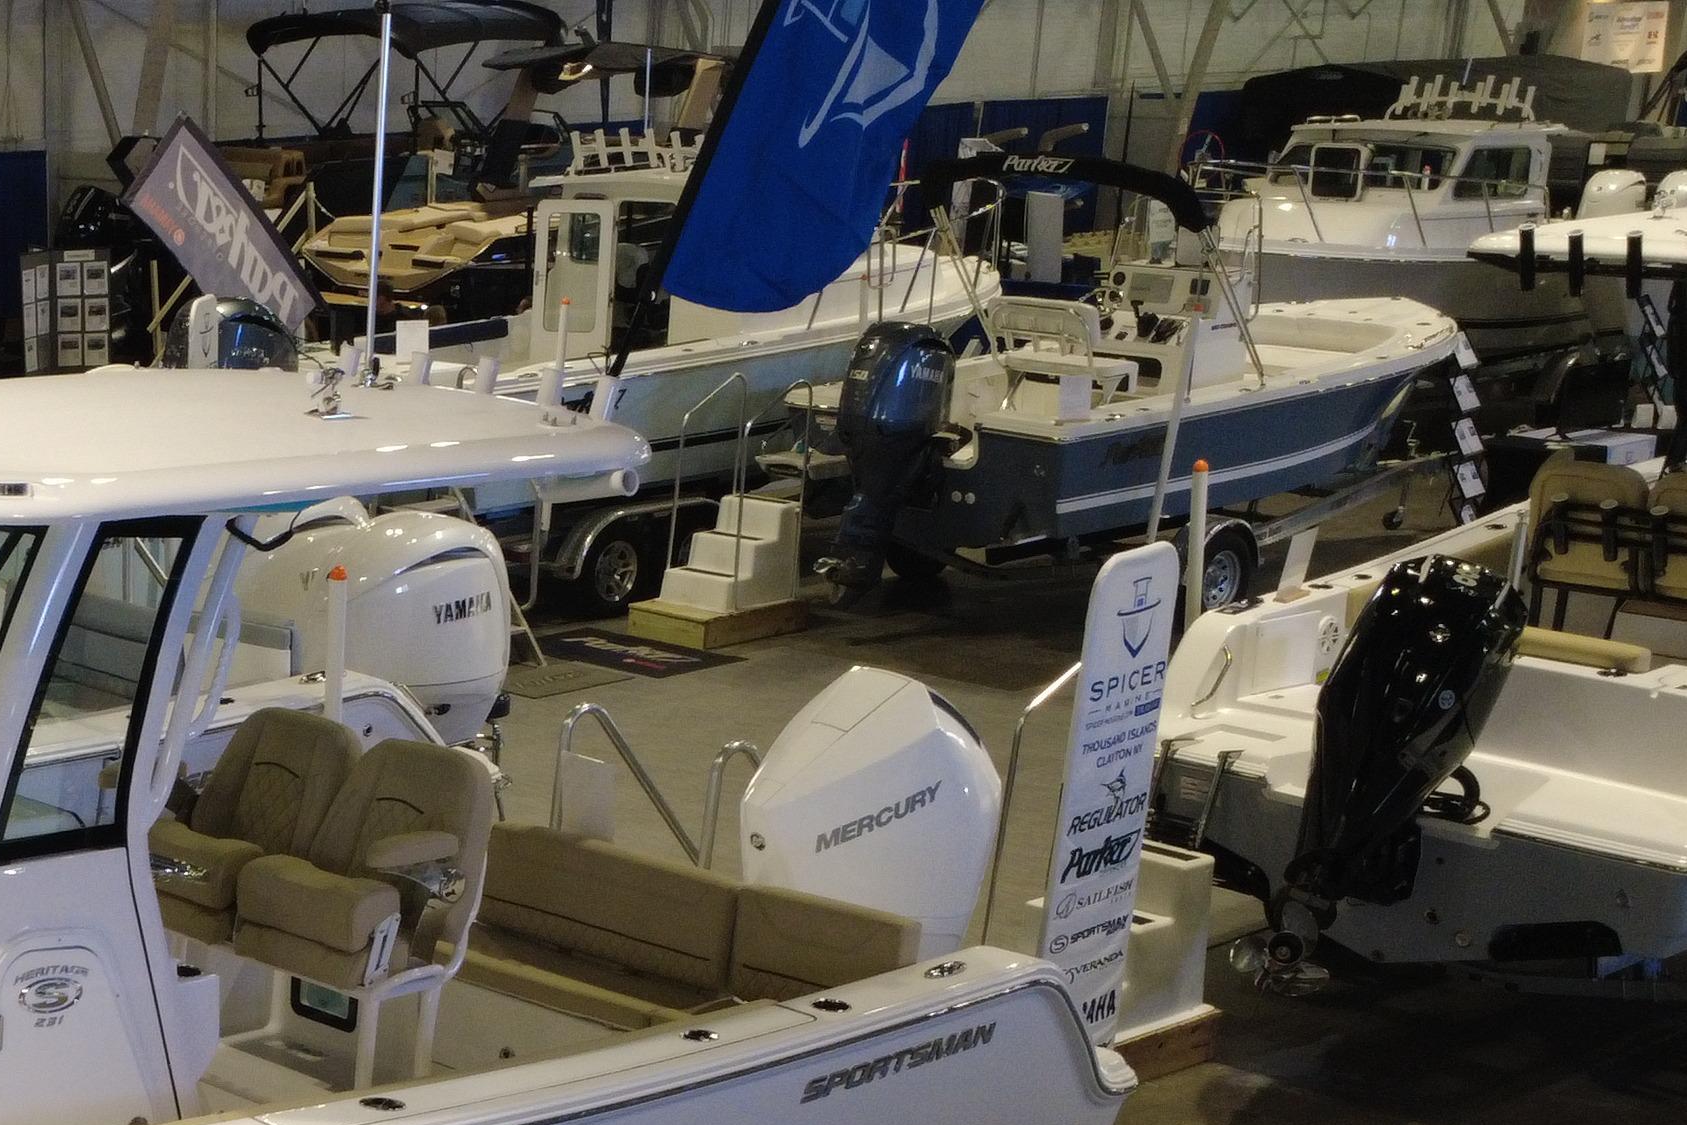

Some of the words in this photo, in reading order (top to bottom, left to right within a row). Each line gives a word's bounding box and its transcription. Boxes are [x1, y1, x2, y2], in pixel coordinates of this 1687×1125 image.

[1002, 154, 1075, 174] Parker
[433, 591, 493, 625] YAMAHA
[1089, 660, 1167, 703] SPICER
[1082, 731, 1126, 755] THOUSAND
[1127, 720, 1158, 741] ISLANDS
[1096, 748, 1132, 769] CLAYTON
[815, 779, 943, 854] MERCURY
[1066, 791, 1148, 837] REGULATOR
[1059, 828, 1142, 884] Parker
[1075, 878, 1135, 911] SAILFISH
[1075, 949, 1125, 976] VERANDA
[1082, 989, 1116, 1024] AHA
[799, 1022, 997, 1105] SPORTSMAN
